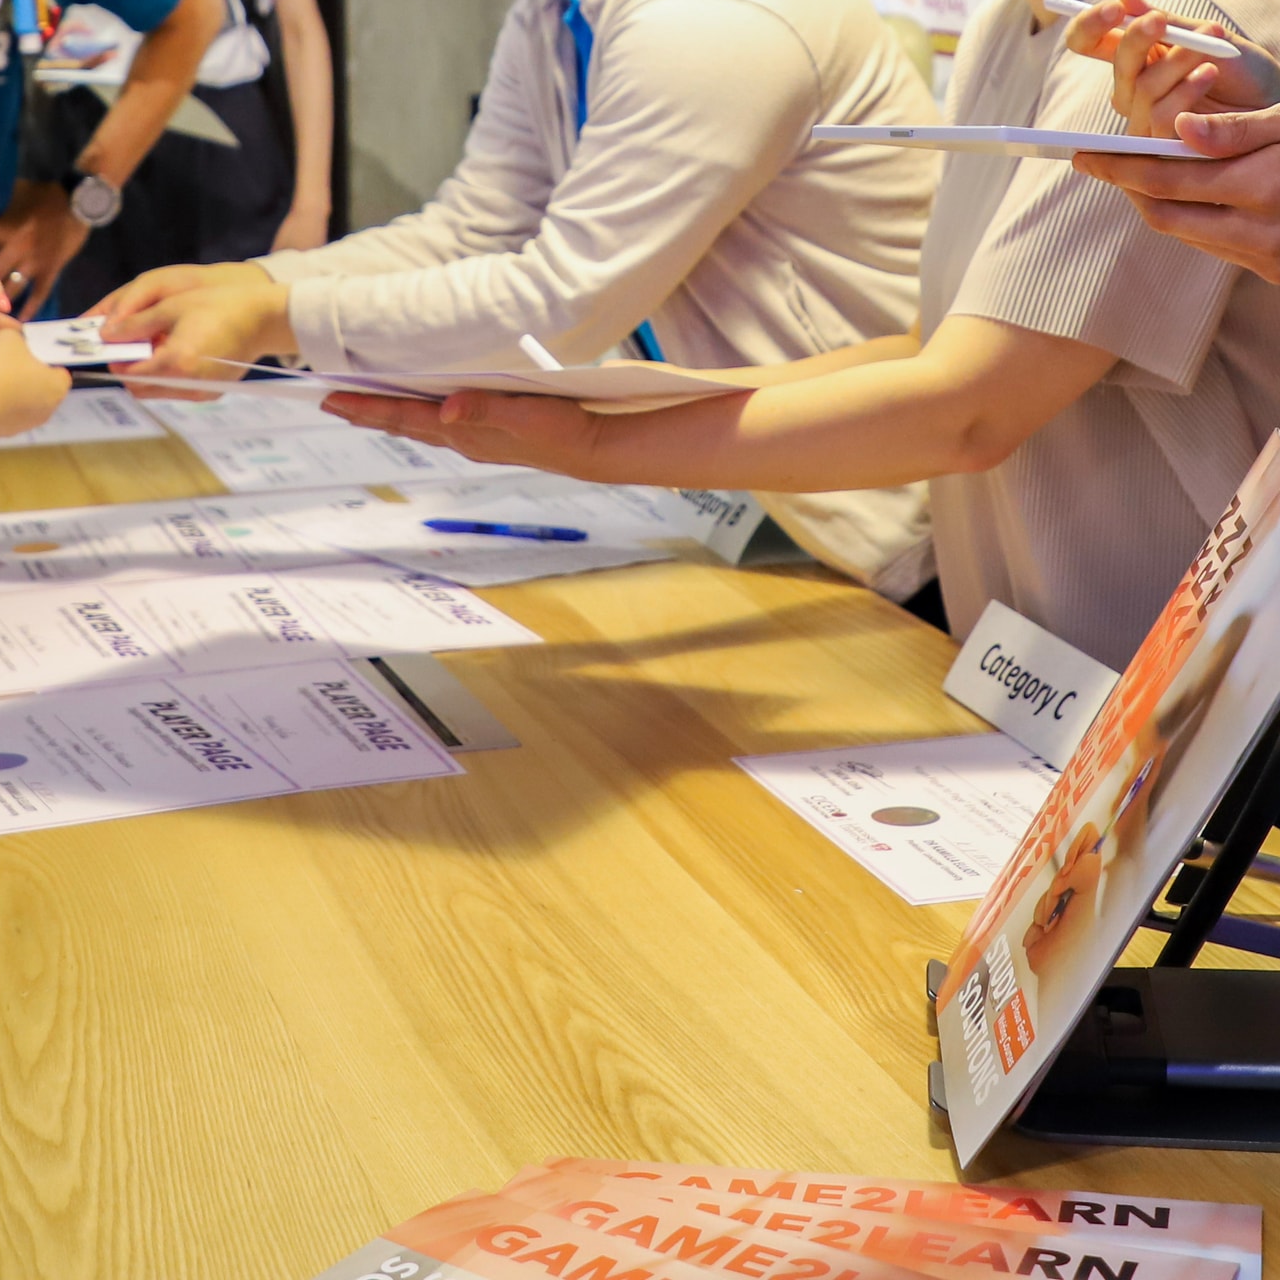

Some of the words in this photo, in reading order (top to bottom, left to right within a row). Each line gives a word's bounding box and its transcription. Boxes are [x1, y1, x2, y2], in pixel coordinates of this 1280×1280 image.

[72, 601, 123, 637] PLAYER
[109, 632, 150, 658] PAGE
[242, 586, 291, 619] PLAYER
[274, 615, 316, 644] PAGE
[312, 680, 377, 727] PLAYER
[353, 716, 414, 752] PAGE
[980, 643, 1058, 716] Category
[1054, 691, 1077, 720] C
[141, 698, 209, 741] PLAYER
[196, 737, 253, 773] PAGE
[986, 933, 1018, 1012] STUDY
[957, 971, 1000, 1108] SOLUTIONS
[1002, 1037, 1016, 1068] Courses
[1017, 1020, 1031, 1050] English
